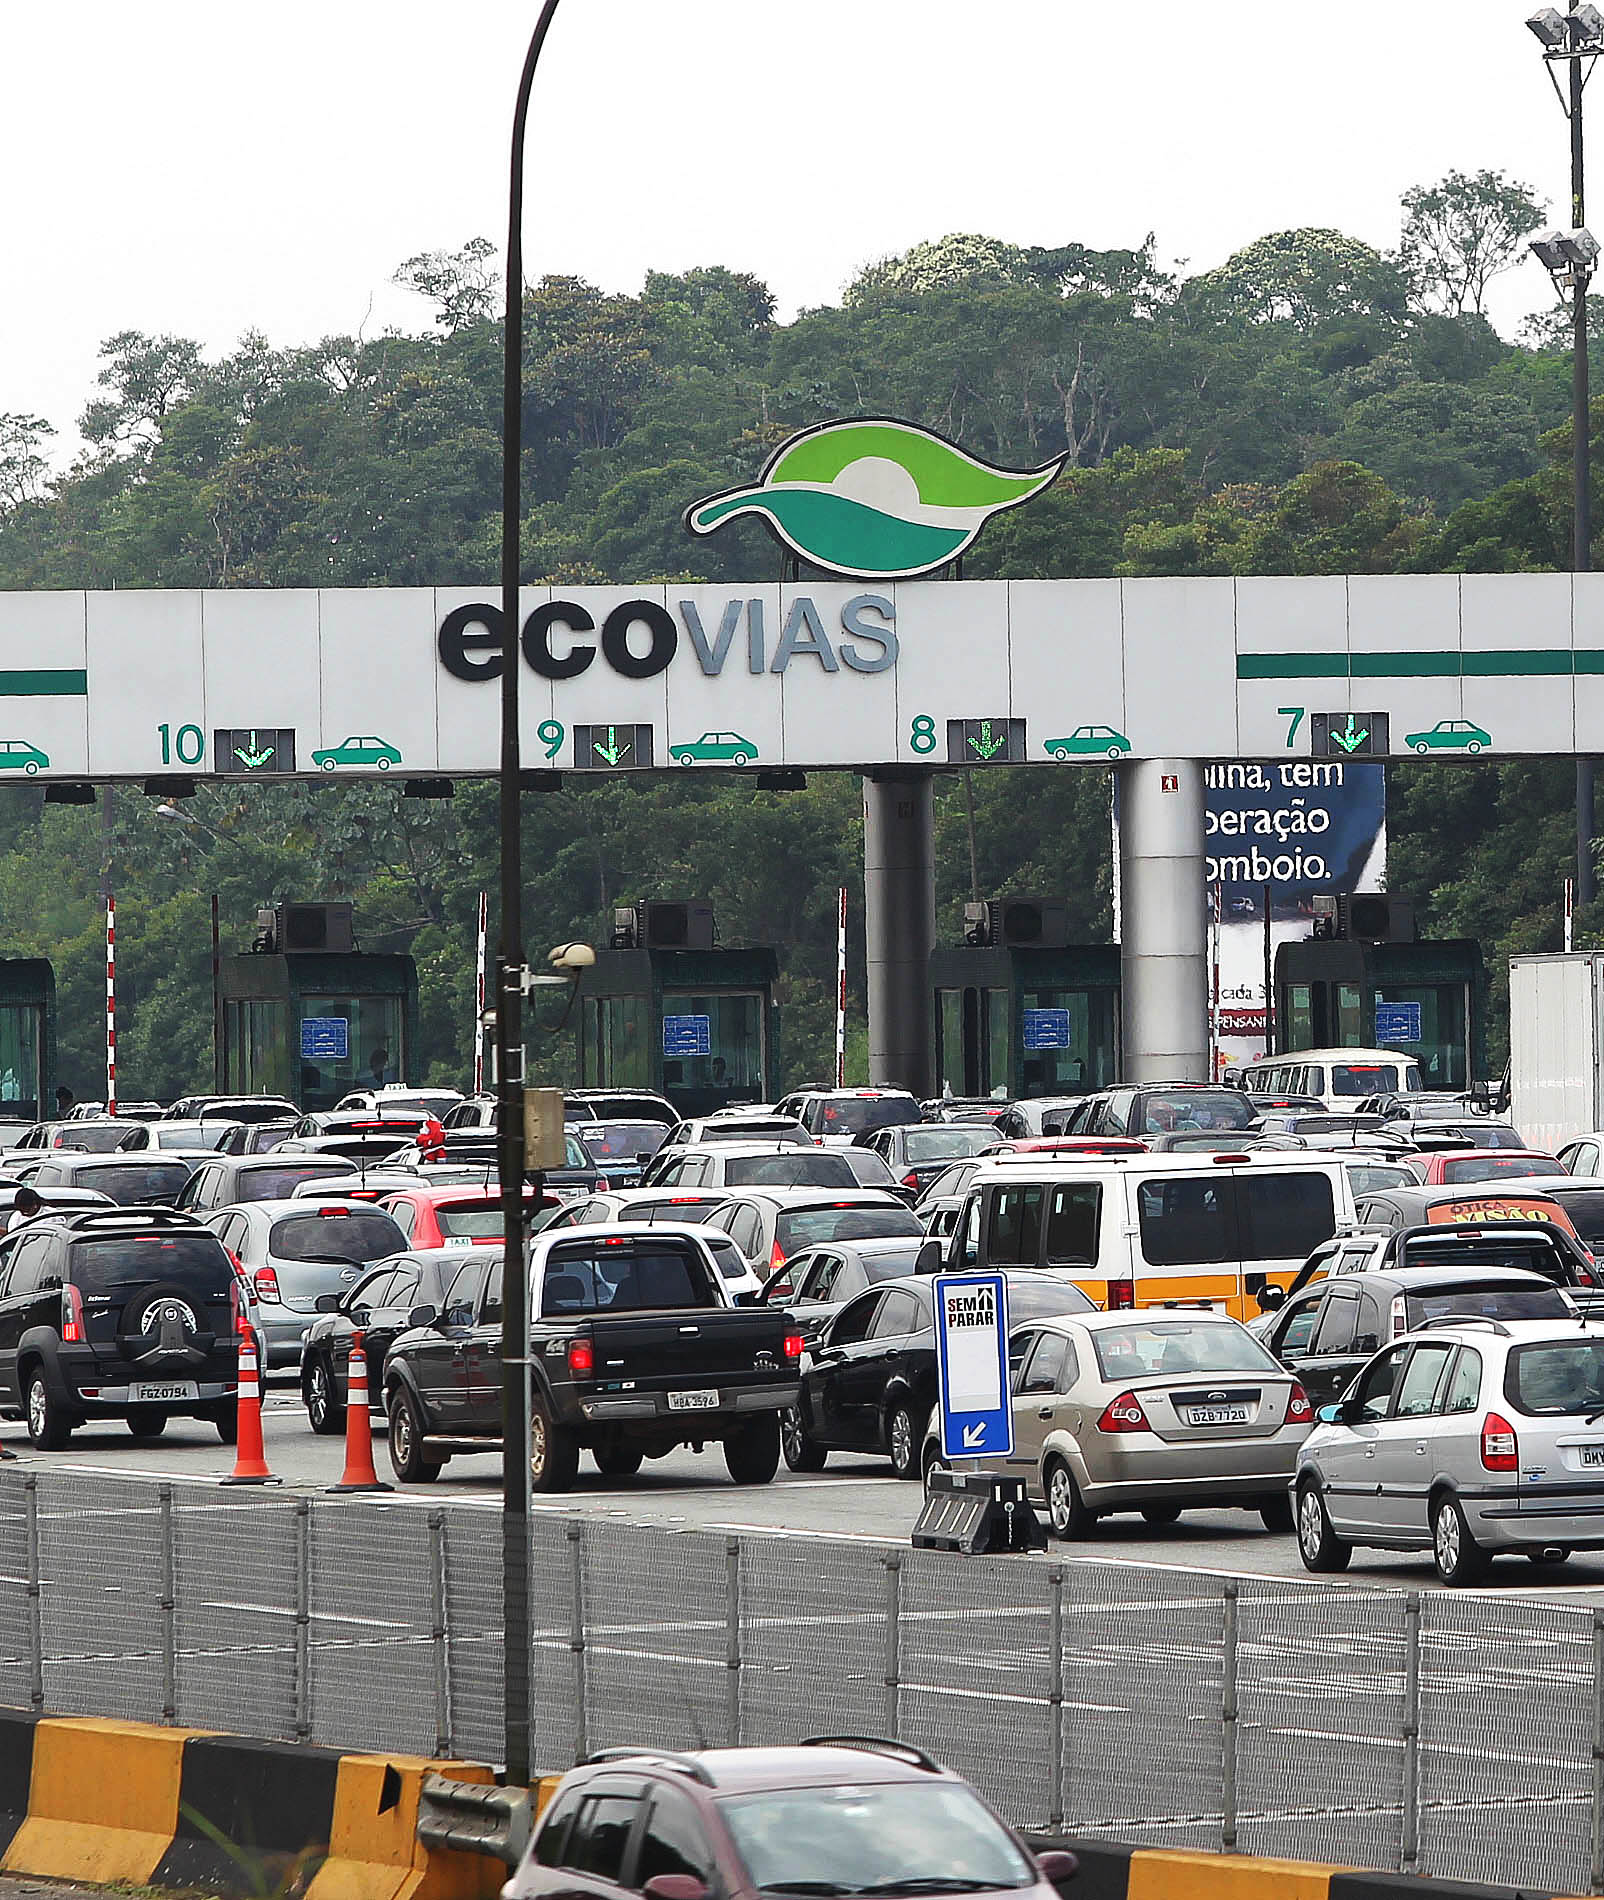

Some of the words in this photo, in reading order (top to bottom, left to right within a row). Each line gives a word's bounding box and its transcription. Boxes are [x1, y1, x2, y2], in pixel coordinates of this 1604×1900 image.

[438, 594, 899, 682] ecoVIAS
[158, 723, 206, 765] 10
[537, 718, 566, 760] 9
[910, 714, 938, 755] 8
[1278, 707, 1306, 748] 7
[947, 1296, 977, 1312] SEM
[948, 1311, 994, 1327] PARAR
[140, 1387, 188, 1399] FGZ-0794
